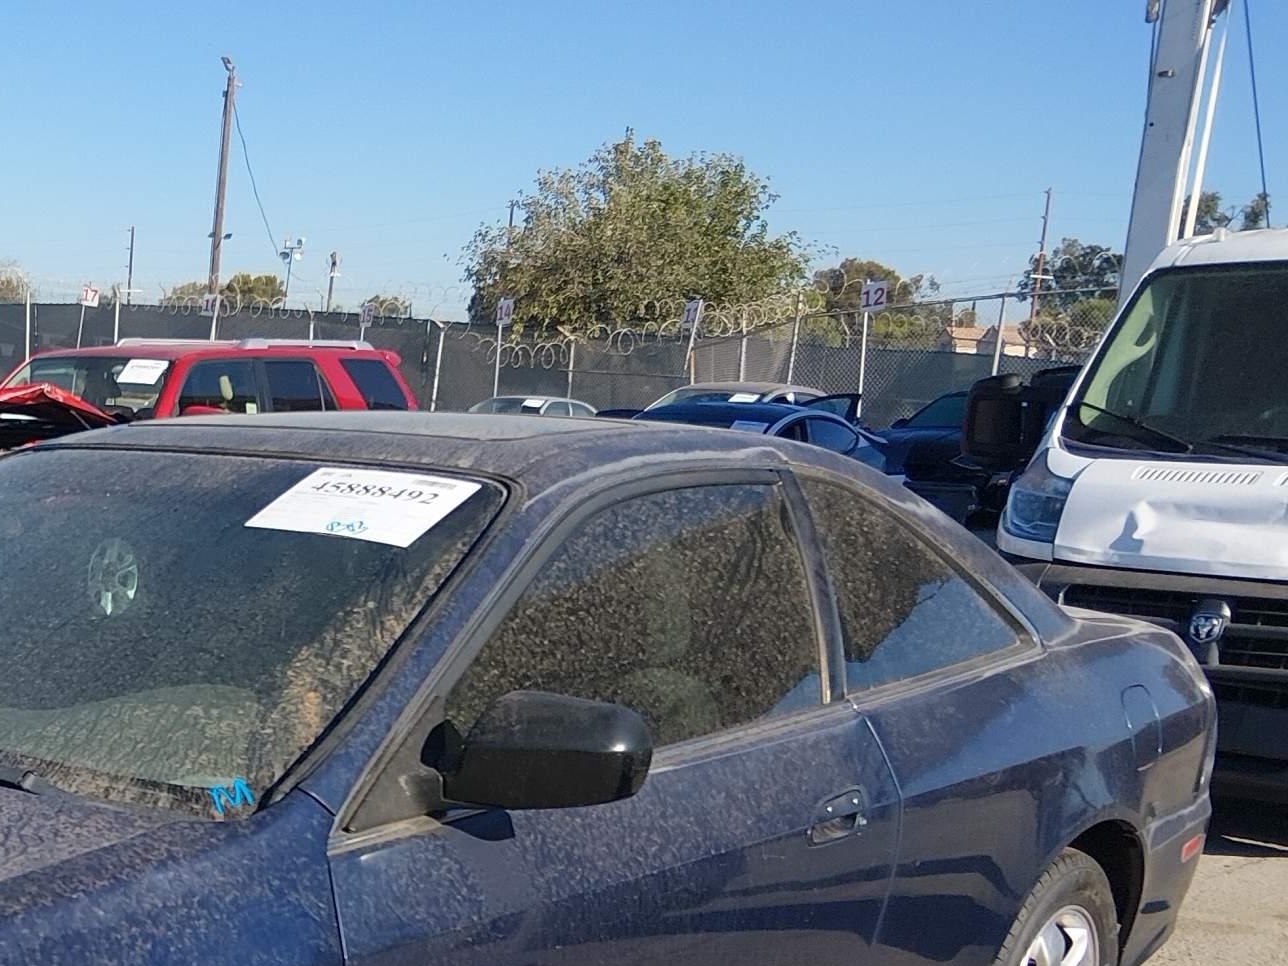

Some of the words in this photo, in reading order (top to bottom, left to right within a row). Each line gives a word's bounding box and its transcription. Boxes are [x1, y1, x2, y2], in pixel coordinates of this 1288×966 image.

[83, 288, 98, 302] 17
[863, 287, 885, 307] 12
[498, 305, 512, 321] 14
[312, 480, 439, 505] 45888492
